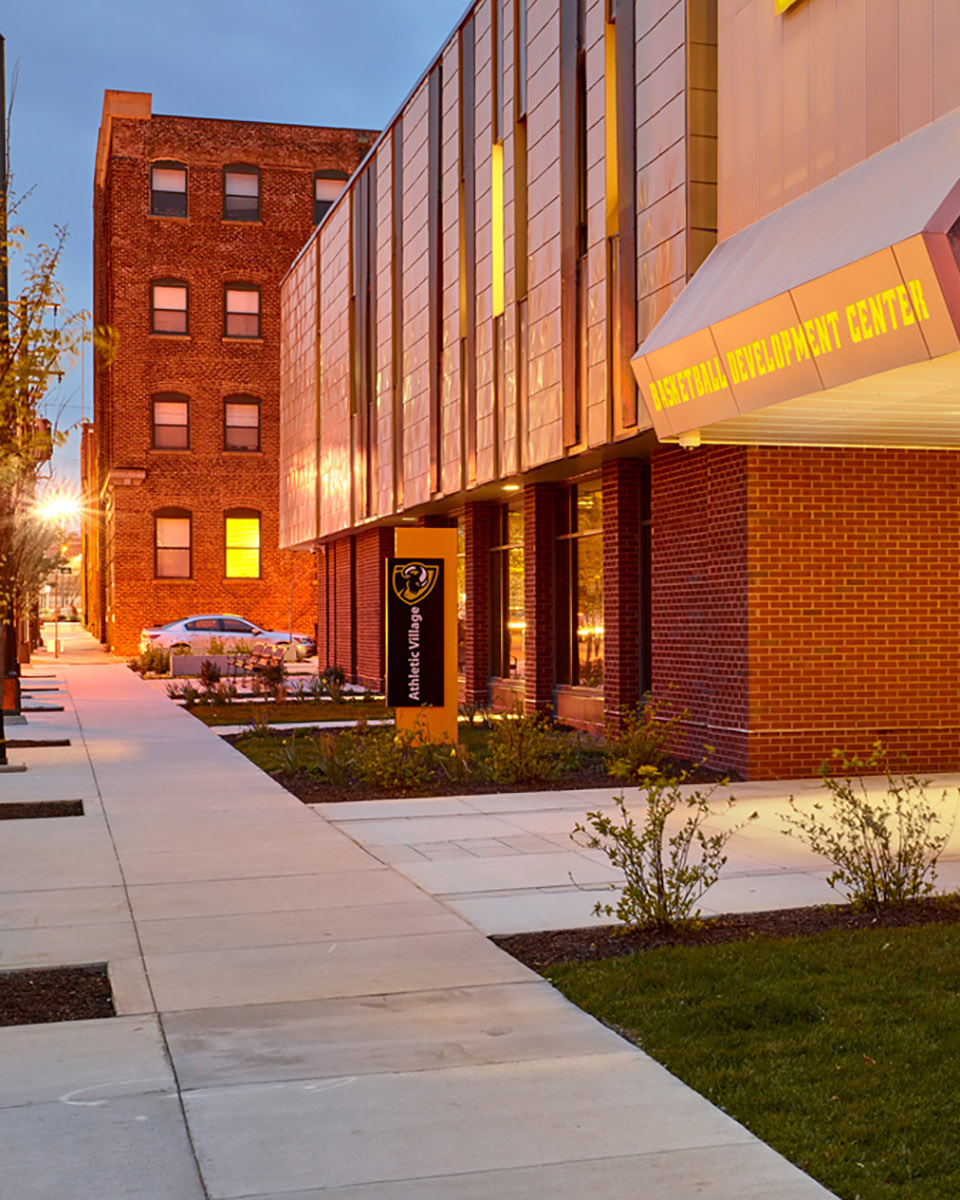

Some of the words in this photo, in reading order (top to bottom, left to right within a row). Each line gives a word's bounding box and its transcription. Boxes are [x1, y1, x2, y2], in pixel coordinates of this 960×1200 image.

[649, 357, 728, 412] BASKETBALL
[726, 310, 842, 385] DEVELOPMENT
[845, 278, 930, 344] CENTER
[409, 607, 422, 649] Village
[409, 652, 420, 700] Athletic
